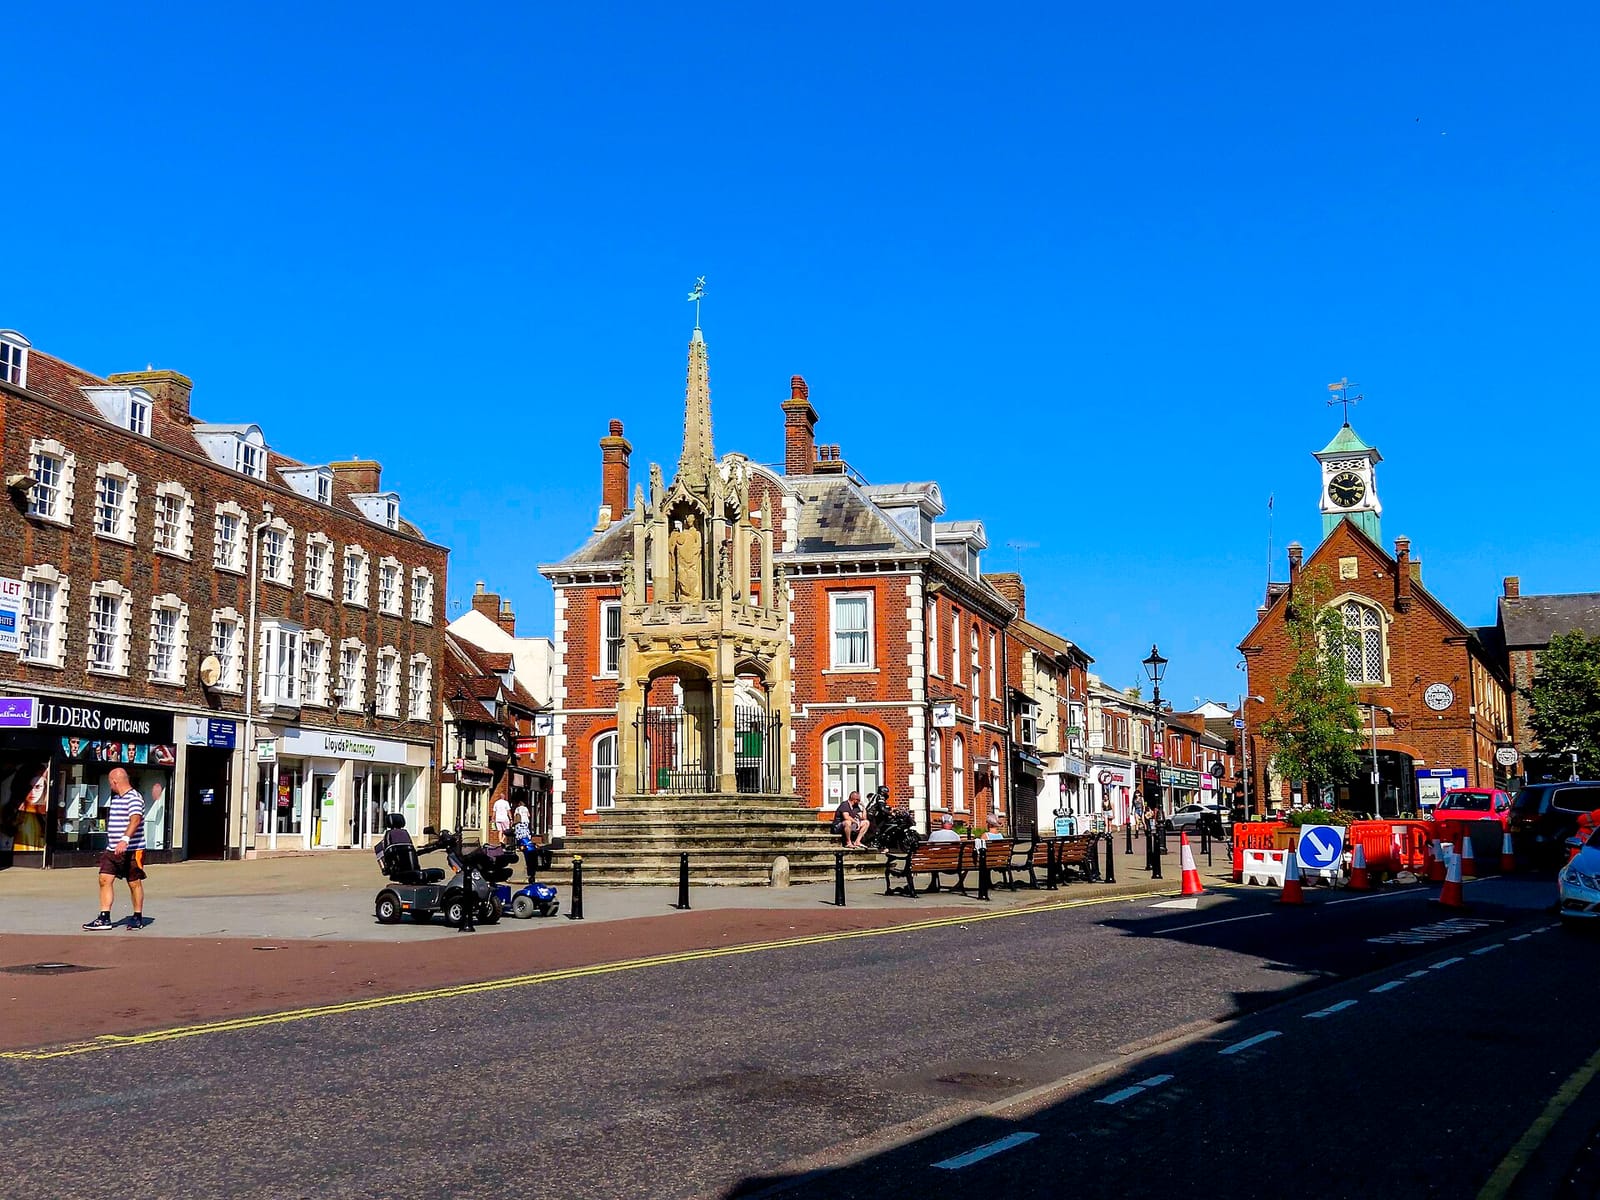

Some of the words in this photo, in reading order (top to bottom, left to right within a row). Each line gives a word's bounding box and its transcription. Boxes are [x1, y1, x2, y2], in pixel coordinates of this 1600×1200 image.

[3, 581, 21, 595] LET
[104, 717, 150, 734] OPTICIANS
[324, 737, 376, 757] LloydsPharmacy
